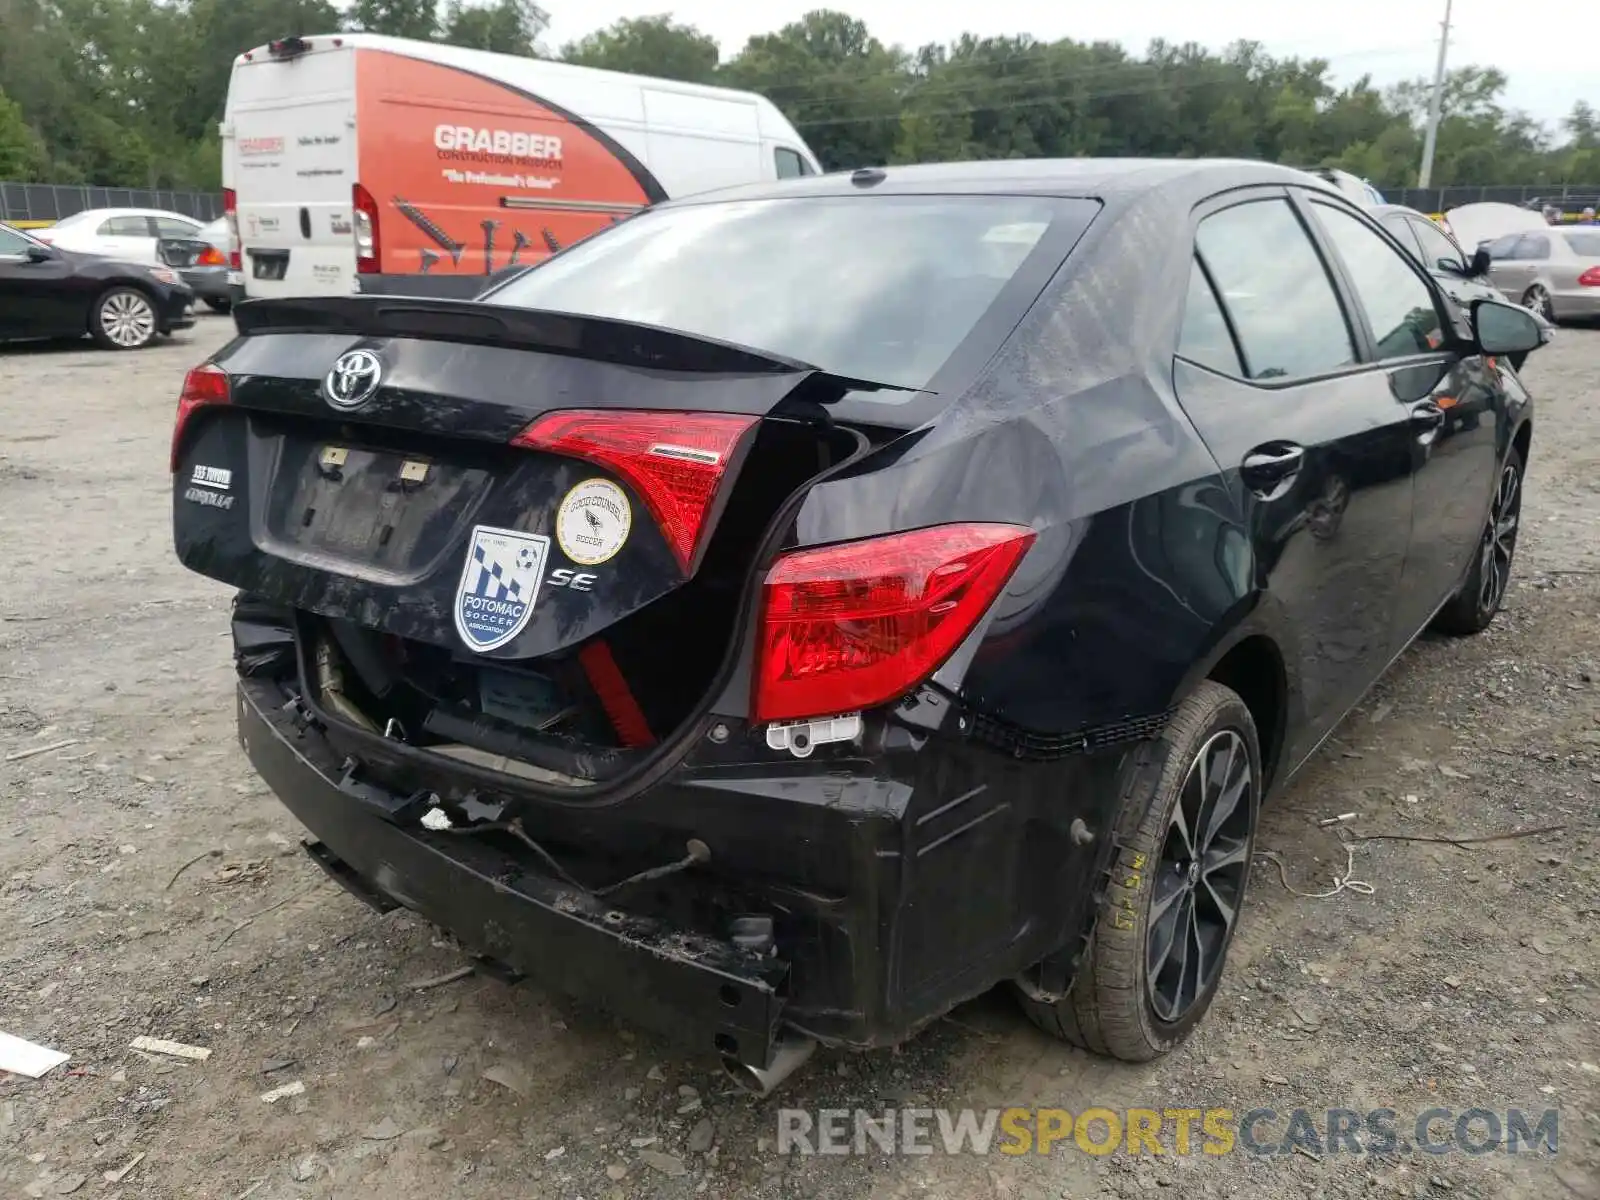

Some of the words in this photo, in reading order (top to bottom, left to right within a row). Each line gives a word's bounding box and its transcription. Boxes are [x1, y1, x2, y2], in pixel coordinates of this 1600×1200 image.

[434, 124, 562, 159] GRABBER
[437, 150, 513, 165] CONSTRUCTION
[516, 156, 563, 170] PRODUCTS
[592, 495, 622, 522] COUNSEL
[576, 534, 605, 547] SOCCER
[545, 568, 598, 592] SE
[464, 596, 523, 617] POTOMAC
[465, 610, 514, 627] SOCCER
[468, 622, 504, 634] ASSOCIATION
